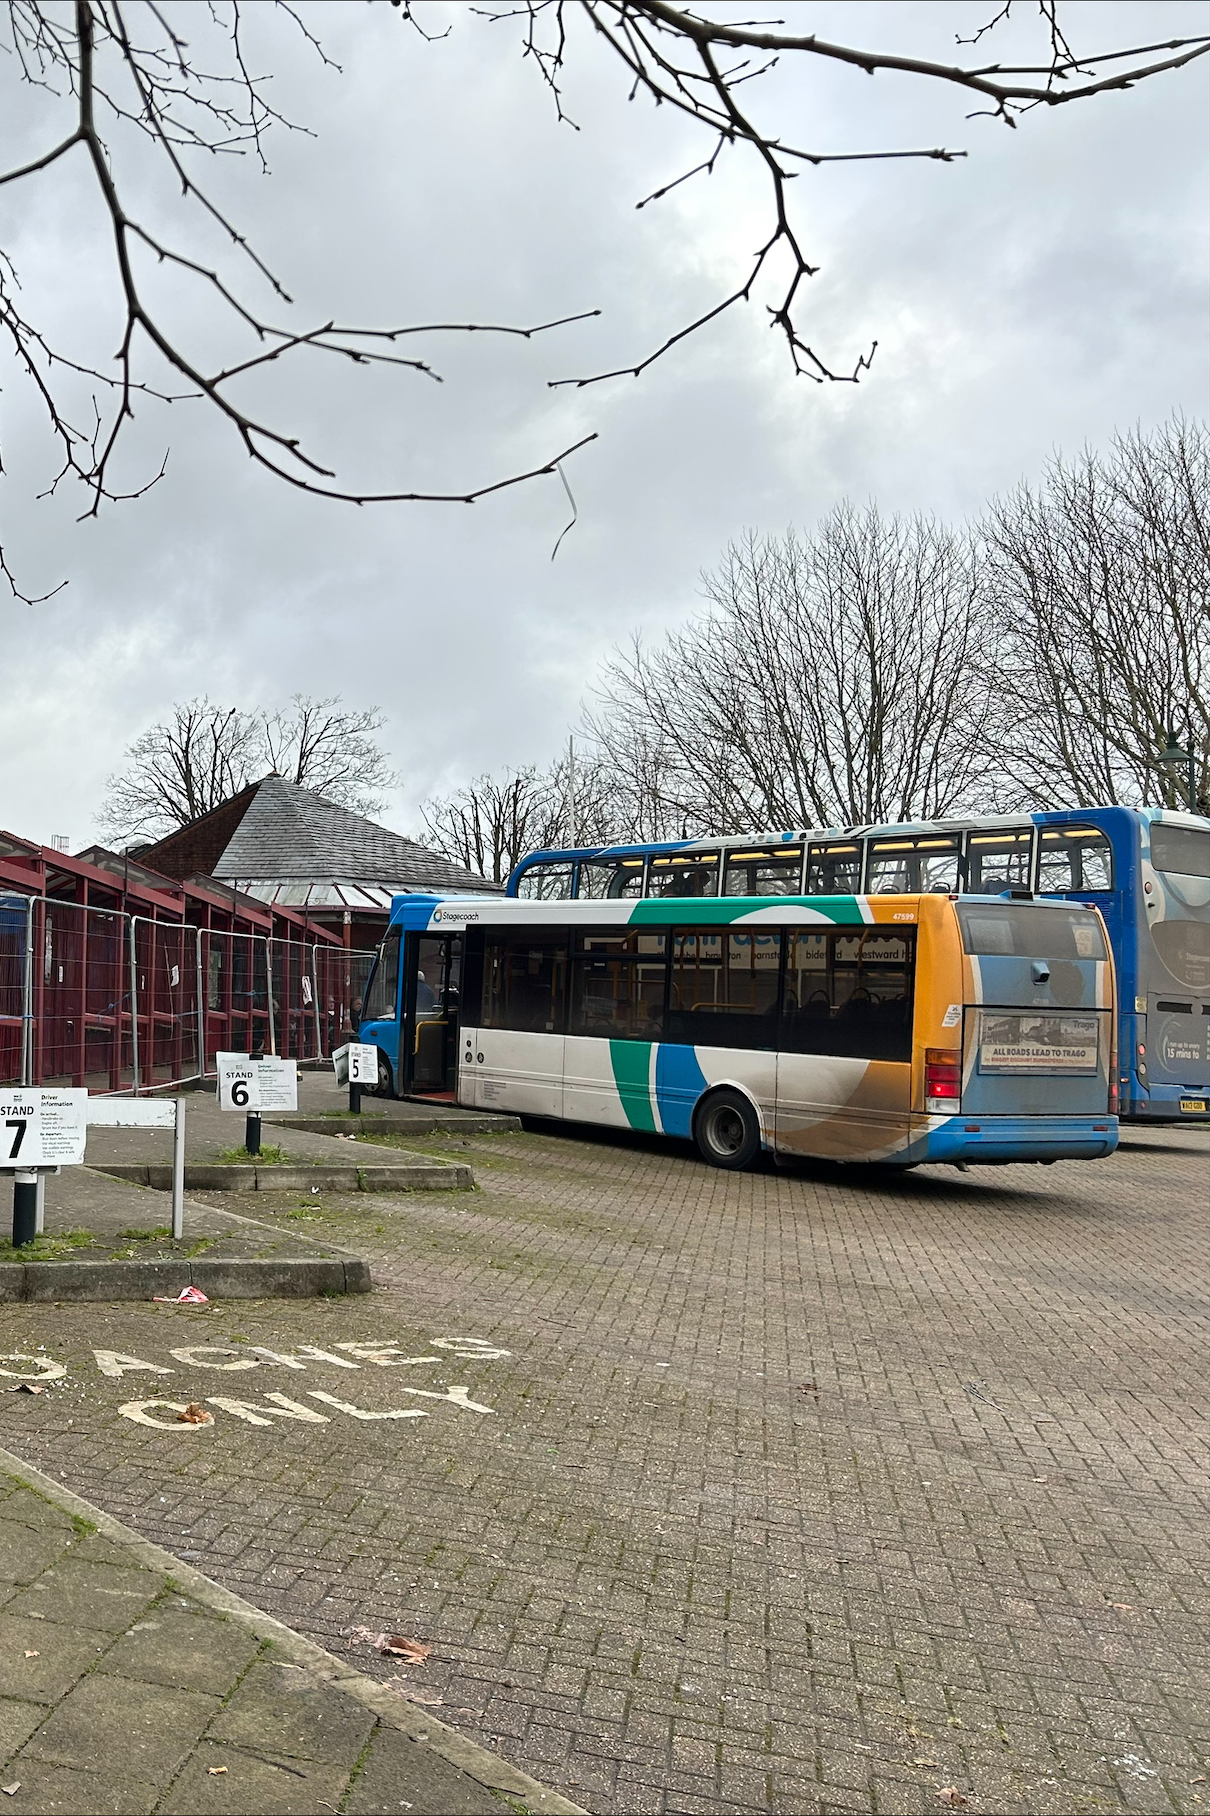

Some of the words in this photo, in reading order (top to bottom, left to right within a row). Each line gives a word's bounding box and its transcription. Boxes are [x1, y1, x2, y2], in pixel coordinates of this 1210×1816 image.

[442, 911, 479, 922] Stagecoach
[892, 912, 914, 921] 47599
[1072, 1019, 1094, 1031] Trago
[993, 1048, 1005, 1056] ALL
[1007, 1048, 1030, 1056] ROADS
[1052, 1049, 1062, 1057] TO
[1167, 1048, 1175, 1058] 15
[1176, 1048, 1191, 1059] mins
[1192, 1050, 1200, 1060] to
[352, 1058, 359, 1078] 5
[226, 1071, 253, 1079] STAND
[231, 1080, 249, 1107] 6
[0, 1106, 34, 1116] STAND
[5, 1119, 27, 1158] 7
[117, 1385, 497, 1432] ONLY
